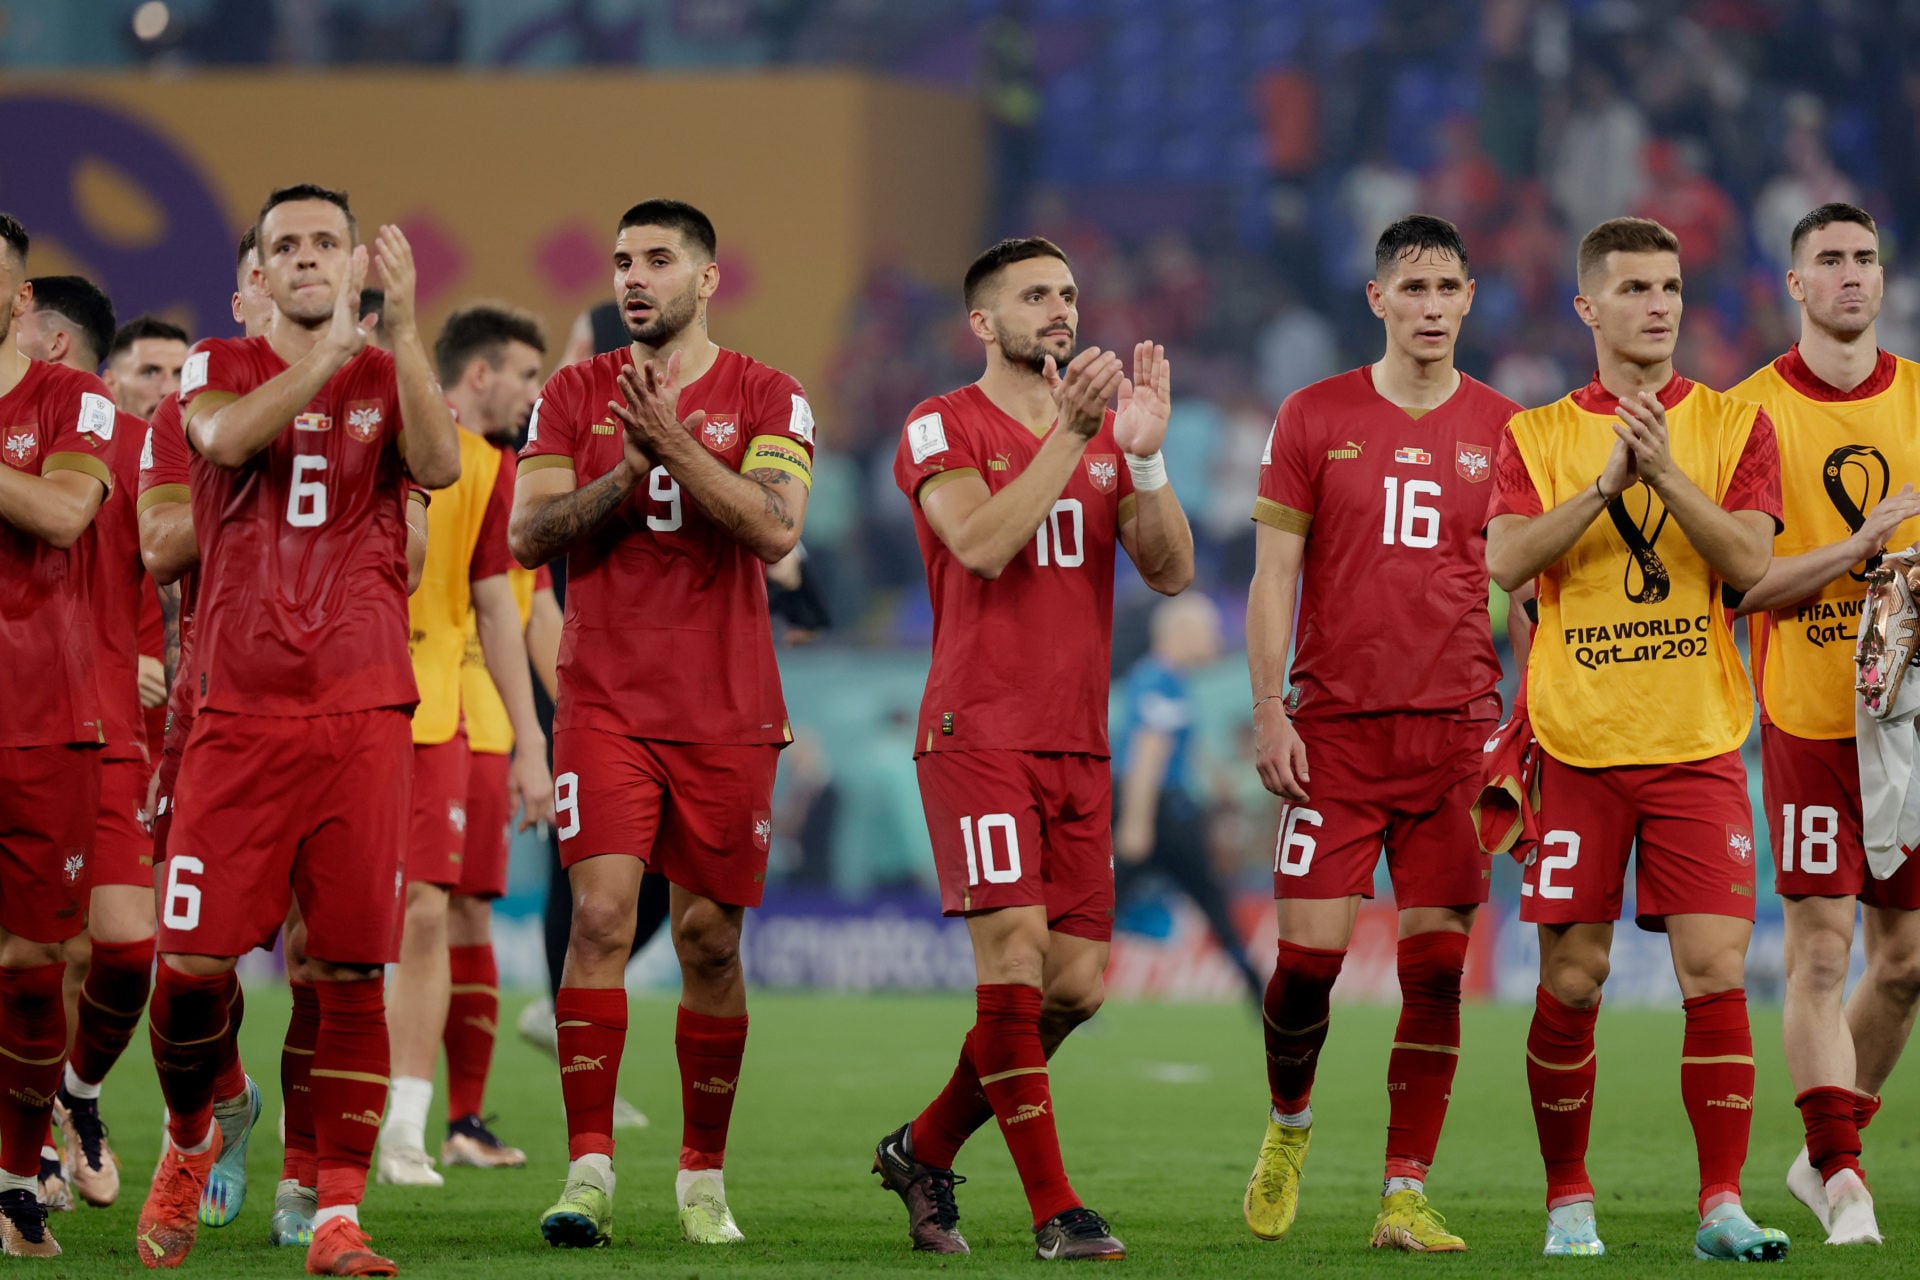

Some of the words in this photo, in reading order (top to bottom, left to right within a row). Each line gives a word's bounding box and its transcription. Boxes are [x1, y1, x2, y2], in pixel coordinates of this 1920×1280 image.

[1328, 449, 1358, 460] PUMA
[287, 454, 327, 528] 6
[646, 464, 683, 532] 9
[1382, 476, 1442, 549] 16
[1035, 498, 1085, 568] 10
[1565, 626, 1611, 645] FIFA
[1612, 617, 1691, 640] WORLD
[1797, 602, 1836, 622] FIFA
[1575, 636, 1707, 671] Qatar202
[554, 771, 581, 841] 9
[960, 813, 1022, 886] 10
[1273, 804, 1324, 877] 16
[1781, 803, 1839, 875] 18
[163, 855, 204, 931] 6
[562, 1062, 596, 1075] PUMA
[693, 1080, 729, 1094] PUMA
[1006, 1109, 1041, 1126] PUMA
[1541, 1101, 1581, 1112] PUMA
[1706, 1099, 1748, 1111] PUMA
